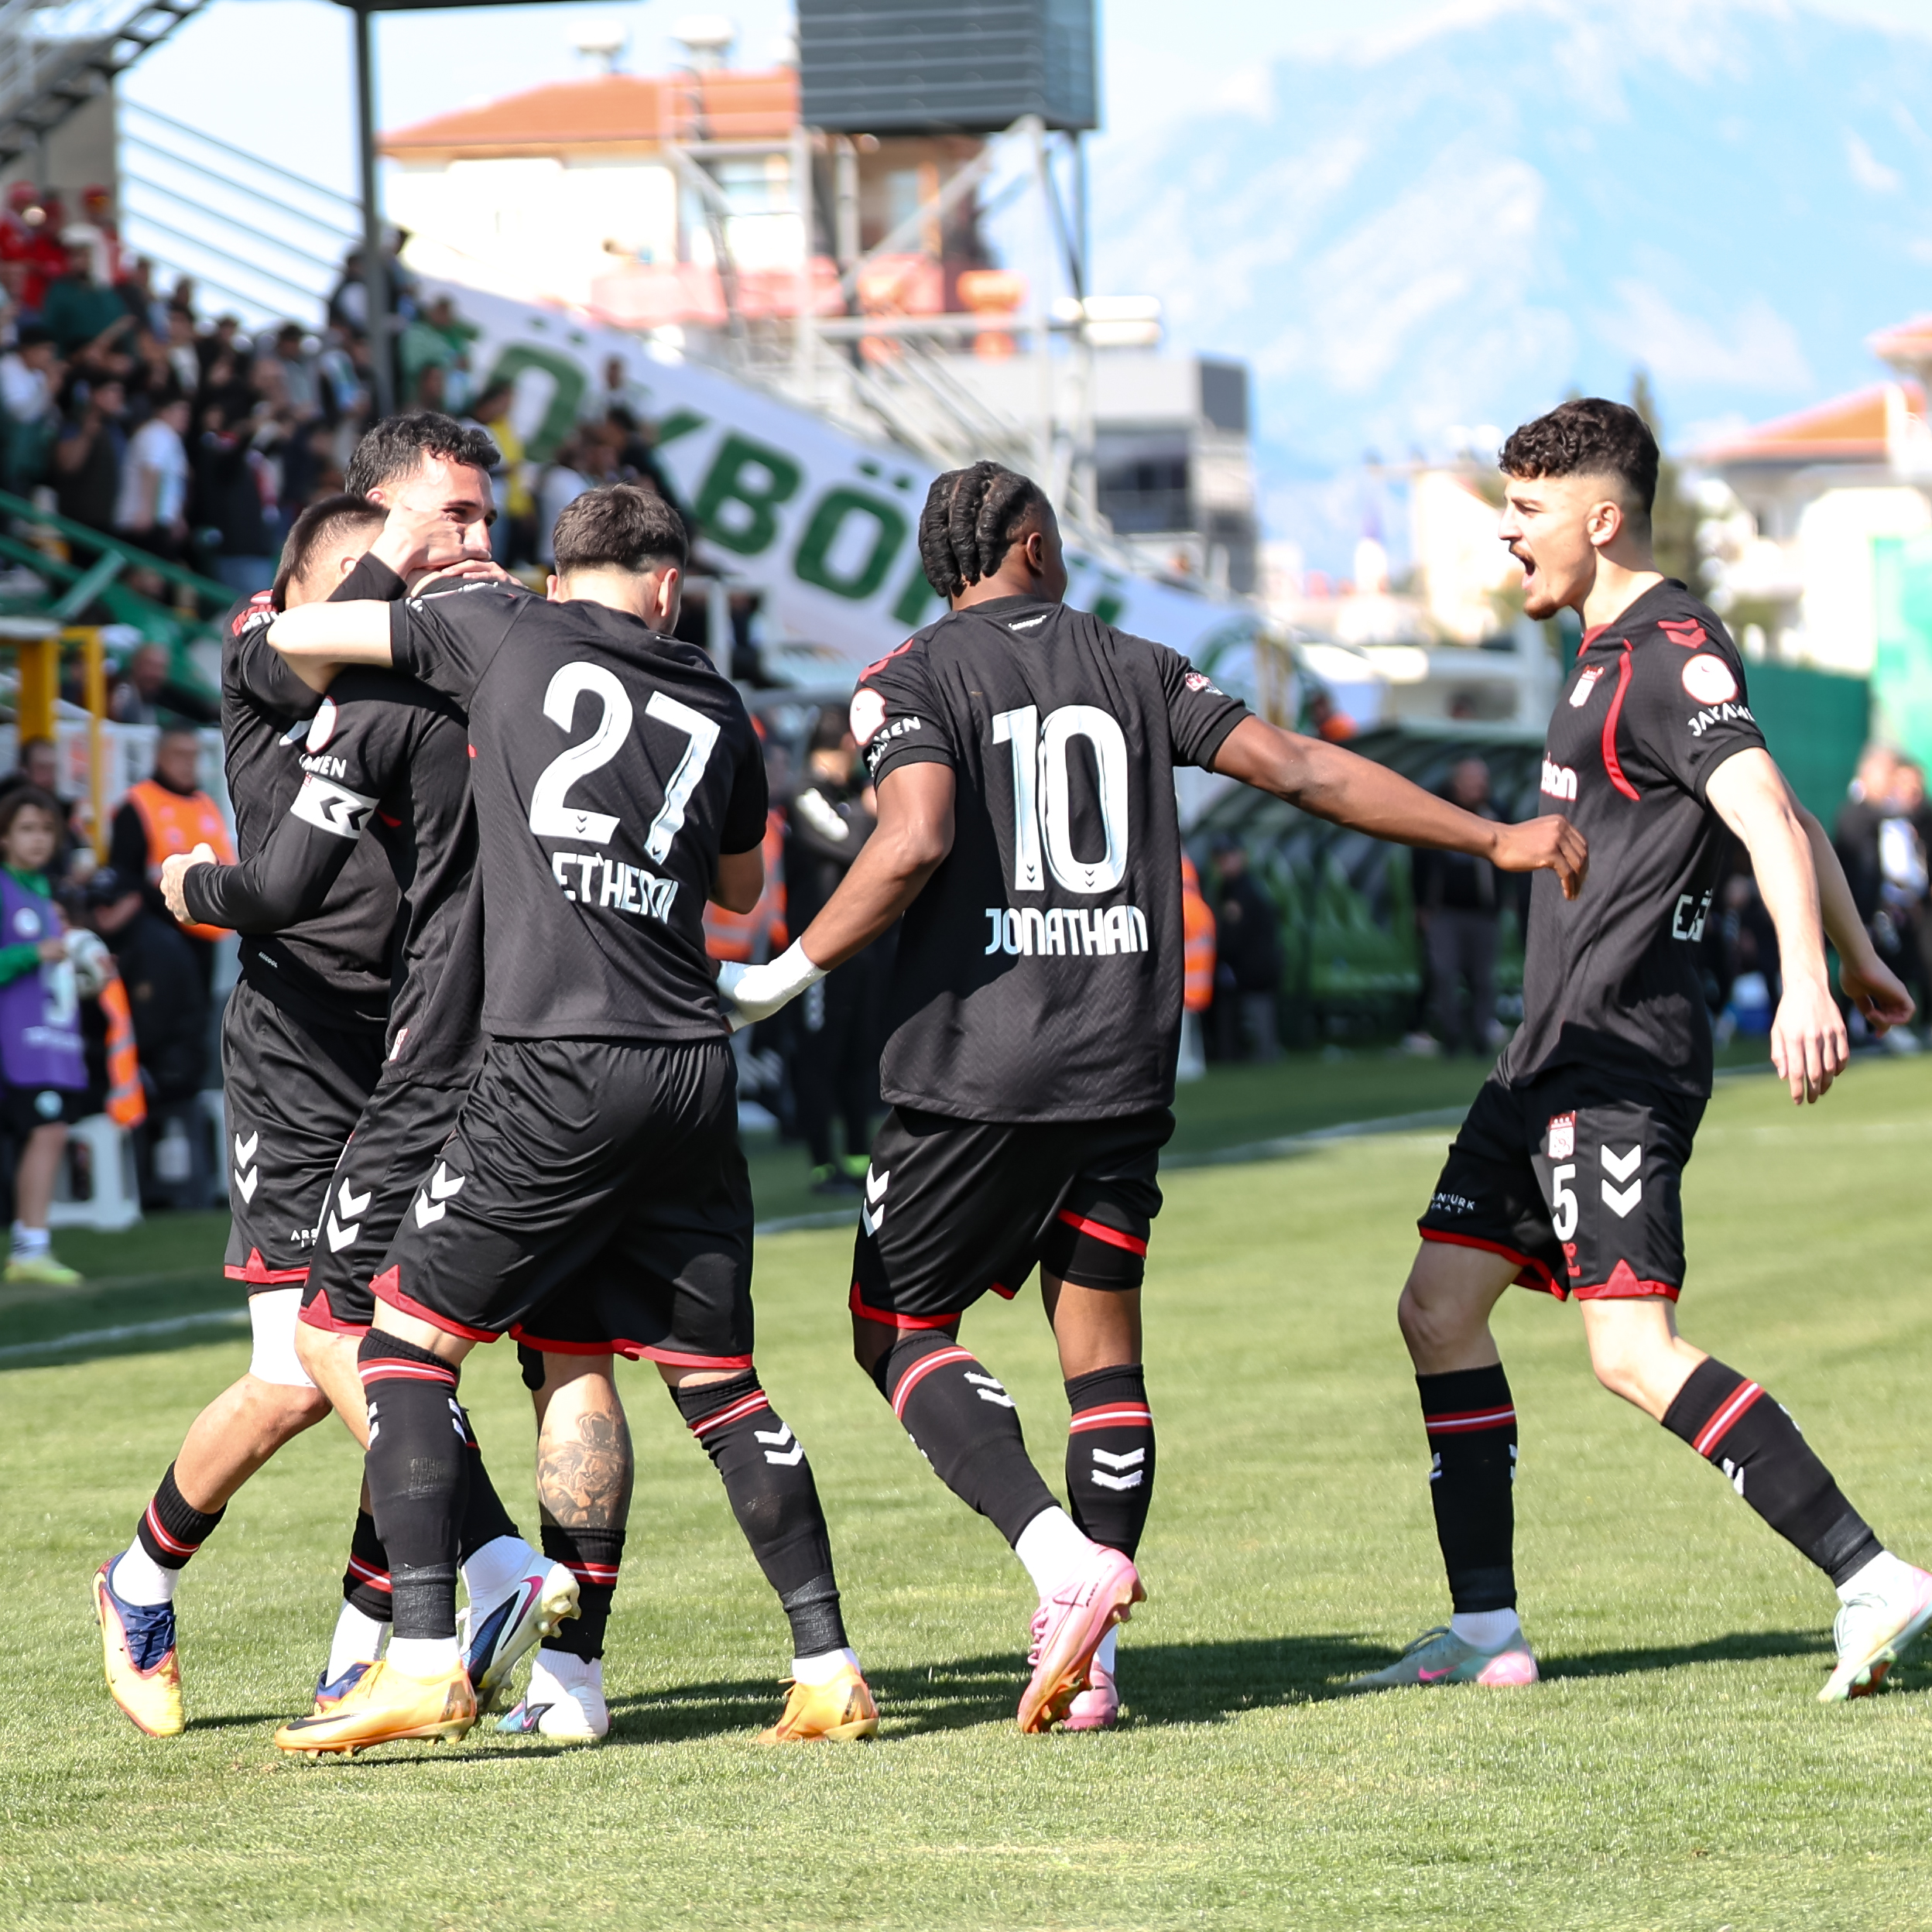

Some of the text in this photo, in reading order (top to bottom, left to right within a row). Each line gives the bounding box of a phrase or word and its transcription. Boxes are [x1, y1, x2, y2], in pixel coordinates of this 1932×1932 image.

[529, 661, 721, 865] 27
[992, 704, 1129, 893] 10
[985, 905, 1149, 956] JONATHAN
[1552, 1163, 1579, 1242] 5
